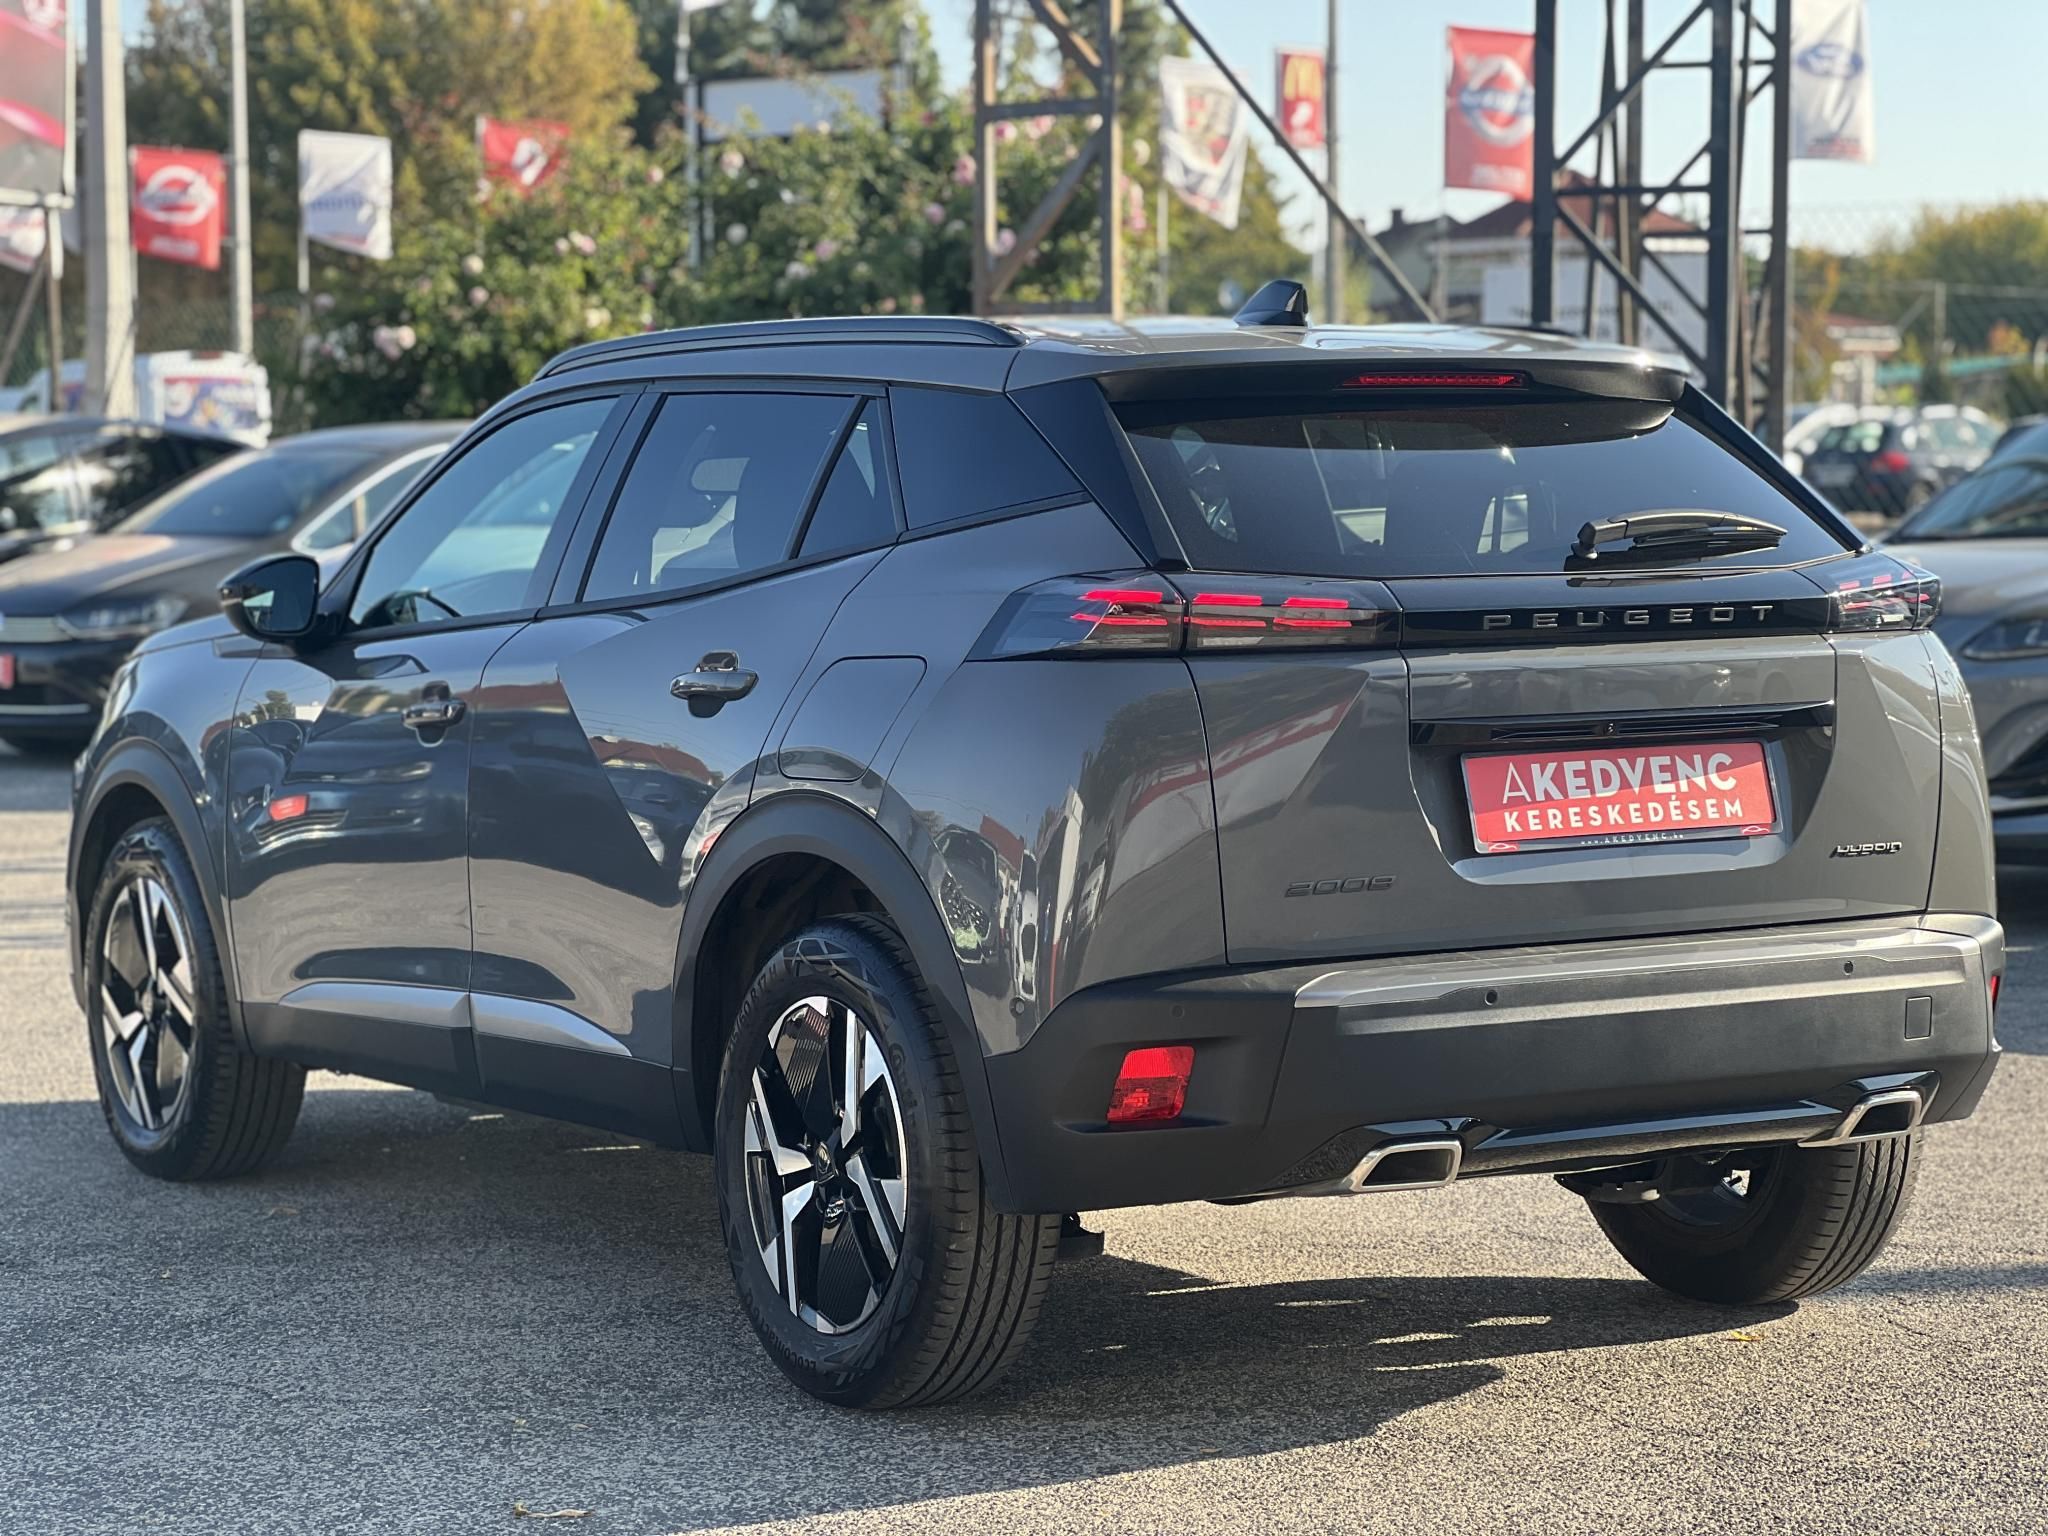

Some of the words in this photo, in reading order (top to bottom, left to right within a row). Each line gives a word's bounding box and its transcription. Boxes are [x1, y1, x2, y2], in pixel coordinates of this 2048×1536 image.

[1483, 605, 1773, 630] PEUGEOT
[1504, 791, 1743, 832] KERESKEDÉSEM
[1284, 875, 1397, 898] 2008
